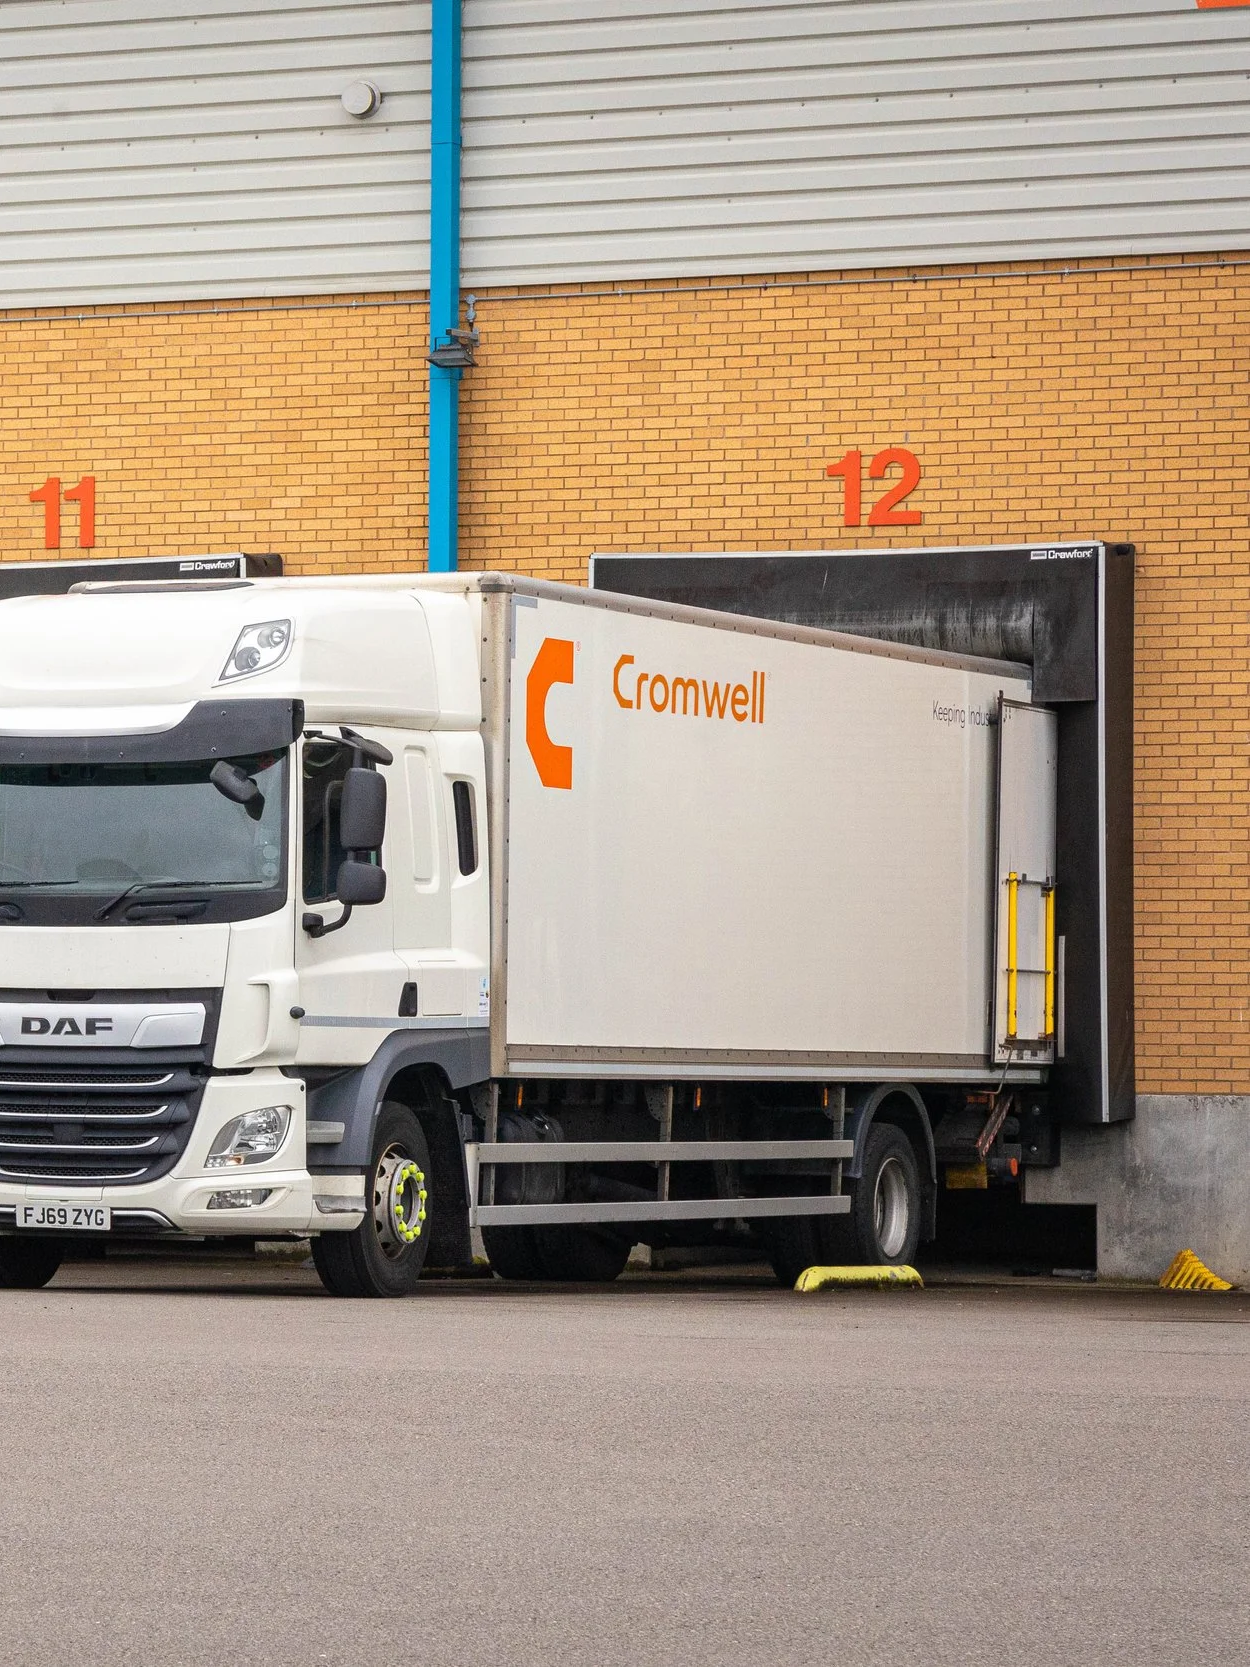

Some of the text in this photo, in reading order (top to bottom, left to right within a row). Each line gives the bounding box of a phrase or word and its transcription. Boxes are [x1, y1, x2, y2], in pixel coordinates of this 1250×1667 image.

[826, 446, 923, 527] 12
[29, 475, 97, 549] 11
[194, 560, 236, 570] Crawford
[612, 653, 766, 723] Cromwell
[932, 700, 966, 729] Keeping
[21, 1016, 113, 1036] DAF
[23, 1207, 104, 1226] FJ69 ZYG
